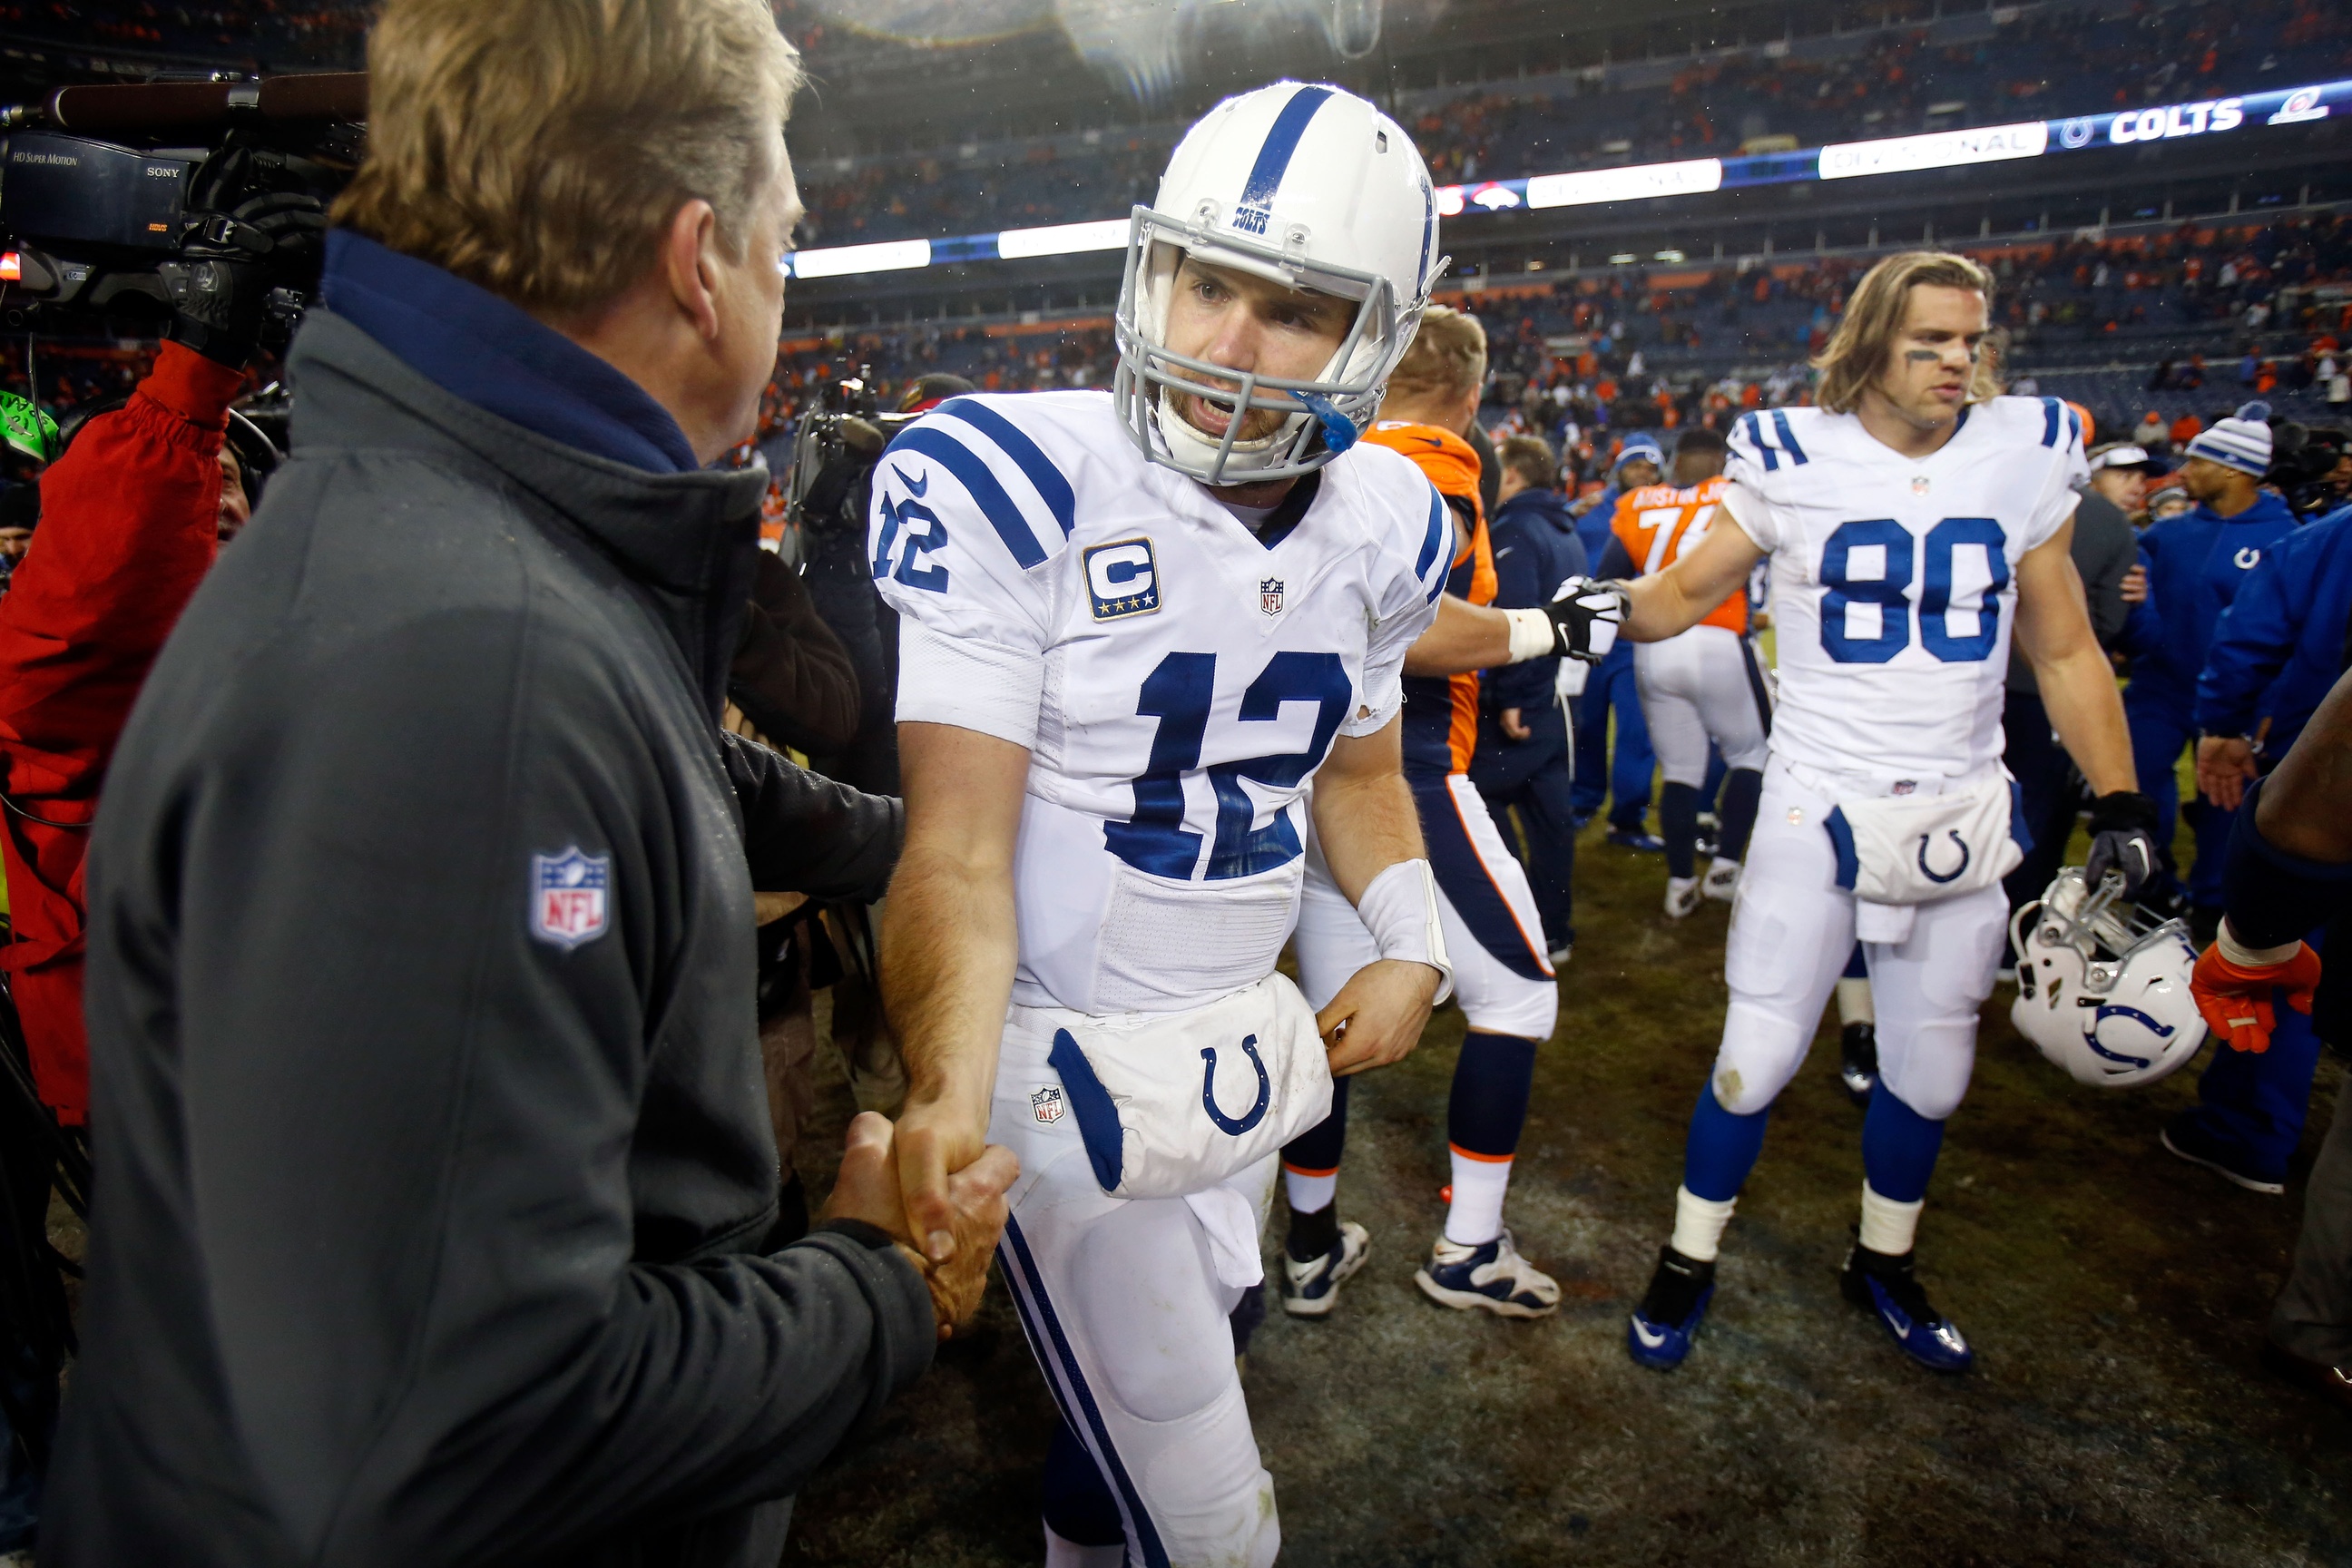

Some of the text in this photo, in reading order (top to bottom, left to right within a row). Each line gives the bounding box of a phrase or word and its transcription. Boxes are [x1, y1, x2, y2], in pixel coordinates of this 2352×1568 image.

[2110, 98, 2243, 144] COLTS
[14, 152, 78, 166] HD SUPER MOTION
[1834, 132, 2029, 169] DIVISONAL
[147, 167, 180, 178] SONY
[1232, 207, 1270, 235] COLTS
[1632, 486, 1699, 509] AUSTIN
[873, 490, 949, 594] 12
[1089, 544, 1152, 600] C
[1819, 516, 2010, 664] 80
[1262, 593, 1281, 612] NFL
[1104, 651, 1354, 881] 12
[545, 892, 603, 933] NFL
[1036, 1101, 1063, 1120] NFL
